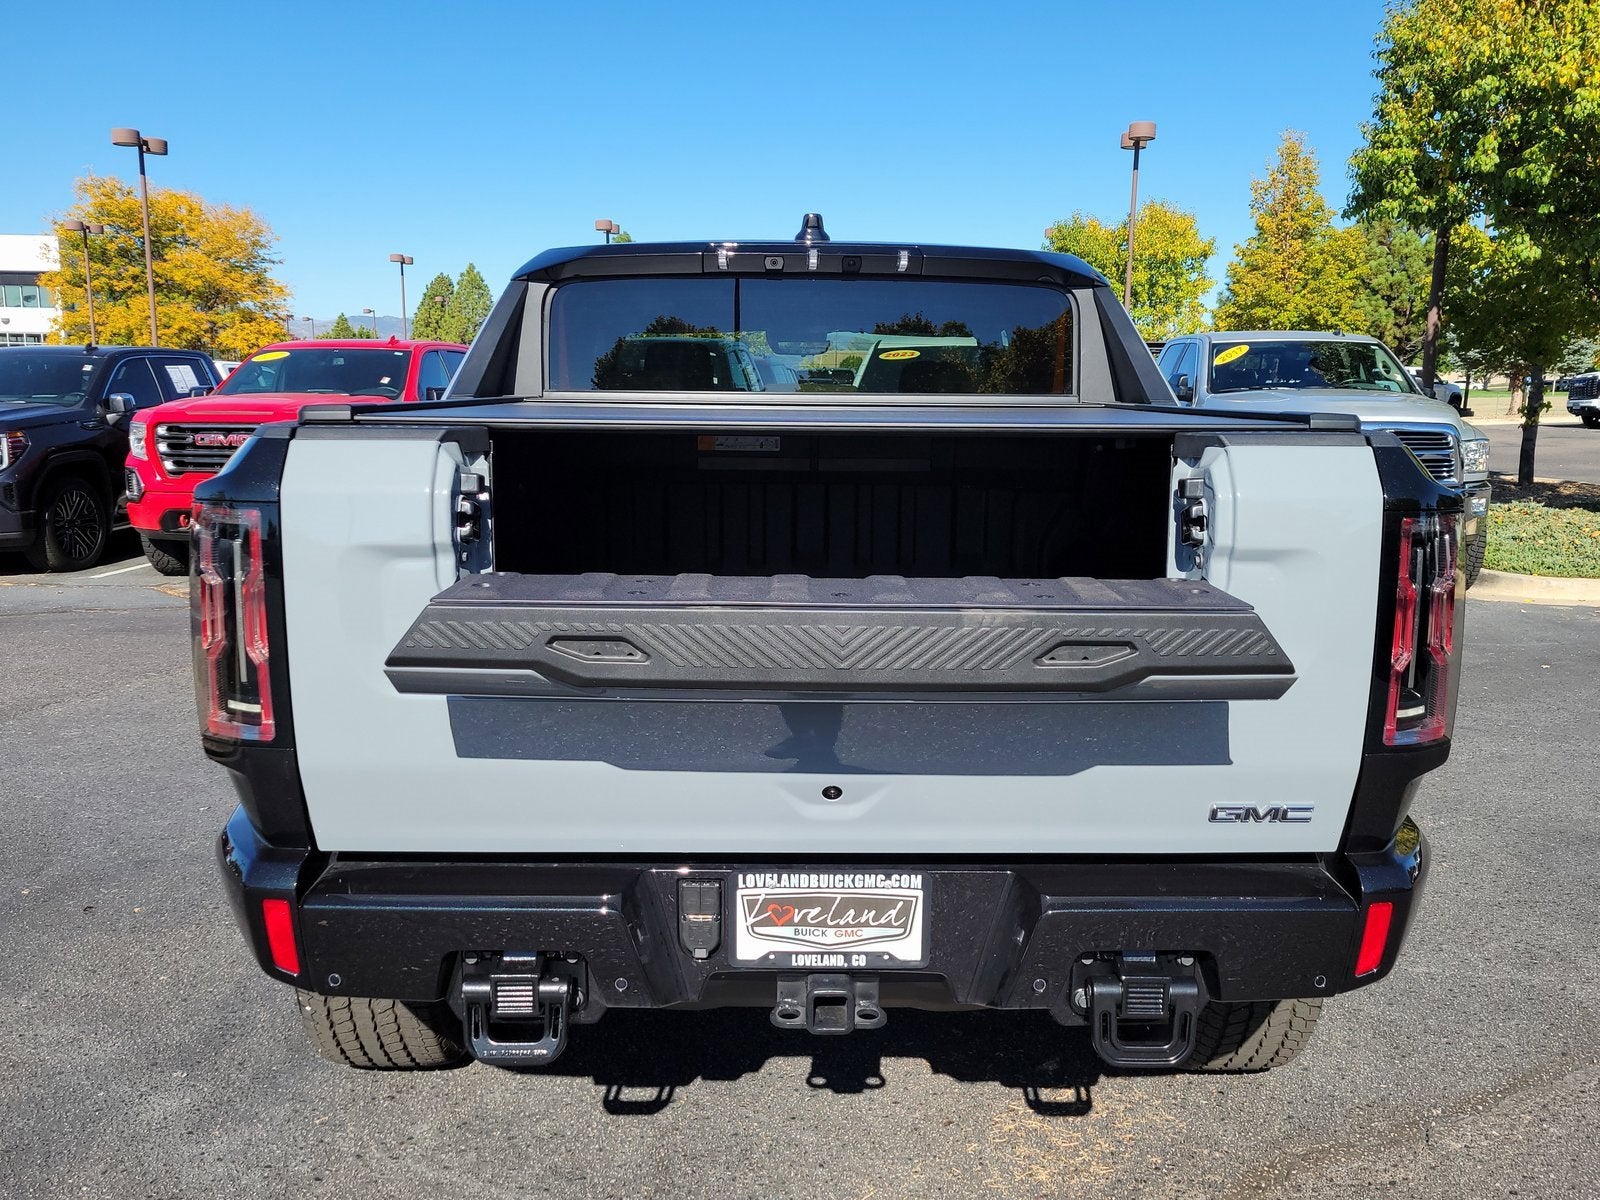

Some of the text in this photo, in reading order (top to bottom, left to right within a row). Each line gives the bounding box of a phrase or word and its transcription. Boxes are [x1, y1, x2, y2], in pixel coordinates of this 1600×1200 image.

[1219, 346, 1242, 362] 2017
[1208, 803, 1315, 823] GMC
[737, 873, 922, 889] LOVELANDBUICKGMC.COM
[746, 893, 906, 927] Loveland
[793, 928, 864, 938] BUICK GMC
[791, 954, 867, 967] LOVELAND, CO
